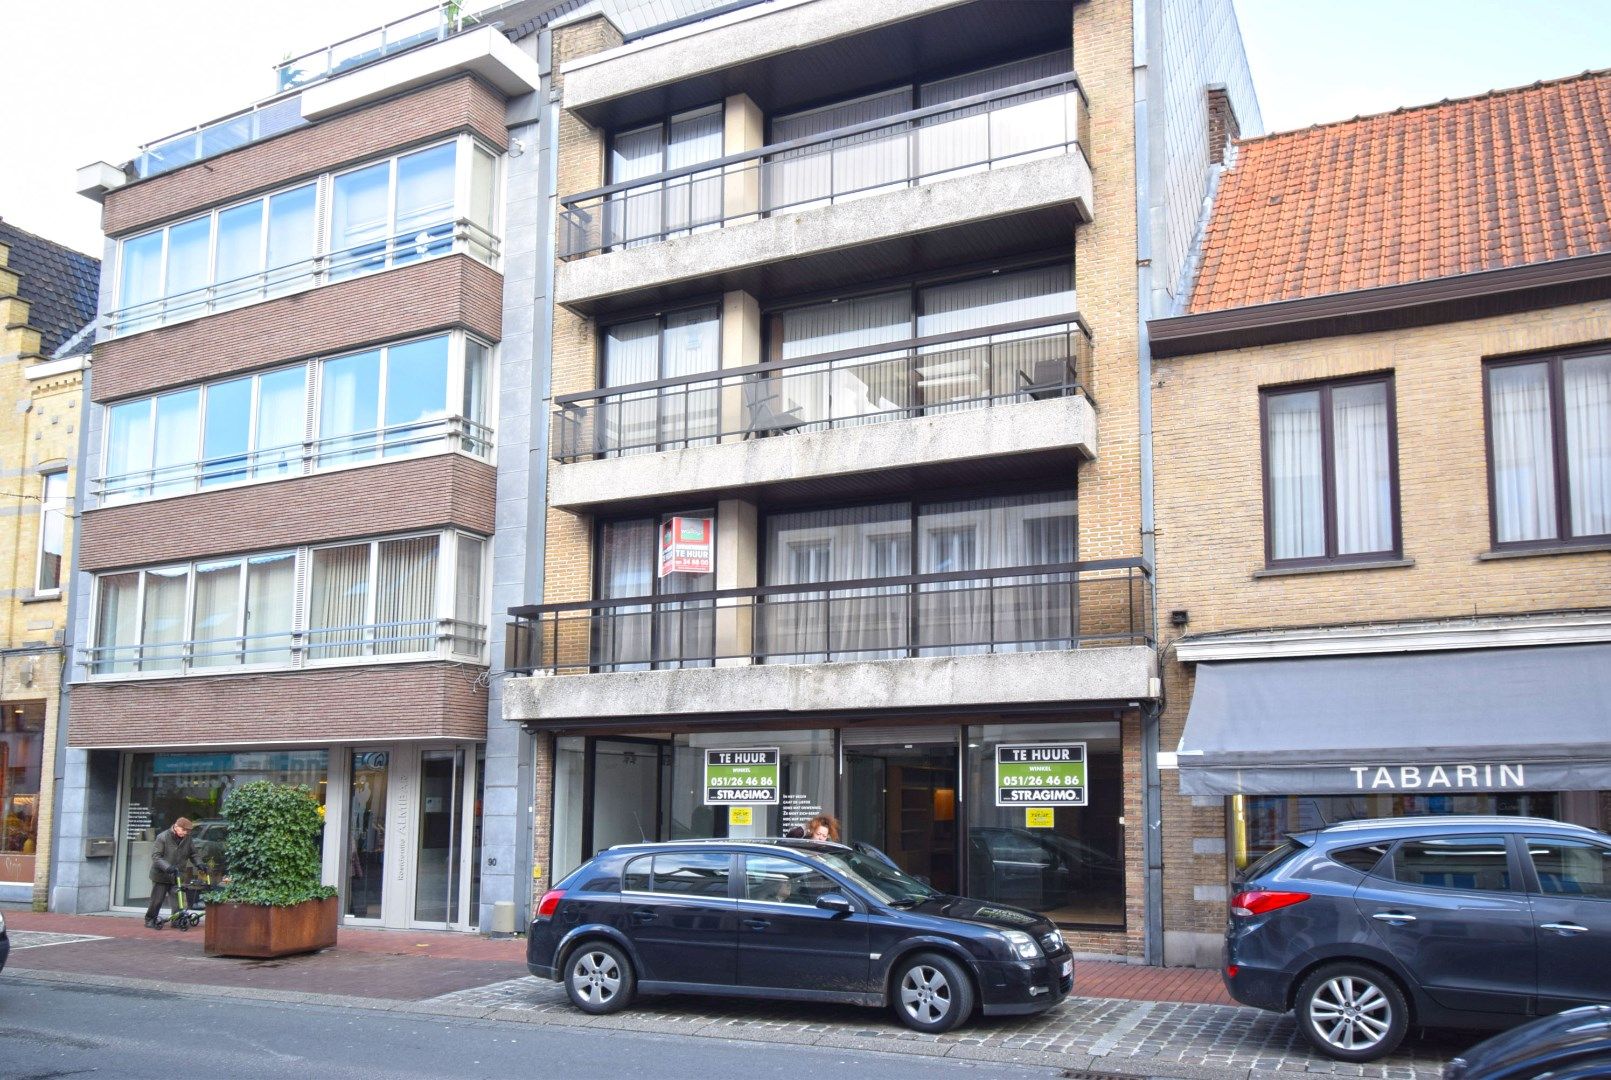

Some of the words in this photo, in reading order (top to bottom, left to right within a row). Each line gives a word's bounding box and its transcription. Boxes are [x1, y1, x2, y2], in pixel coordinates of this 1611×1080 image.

[687, 550, 708, 559] HUUR
[720, 754, 731, 763] TE
[735, 753, 766, 763] HUUR
[1012, 750, 1027, 761] TE
[1032, 749, 1070, 760] HUUR
[711, 777, 743, 786] 051/26
[745, 776, 757, 786] 46
[760, 776, 773, 786] 86
[1003, 776, 1043, 786] 051/26
[1045, 776, 1061, 785] 46
[1064, 775, 1080, 785] 86
[1350, 764, 1525, 789] TABARIN
[487, 857, 497, 867] 90
